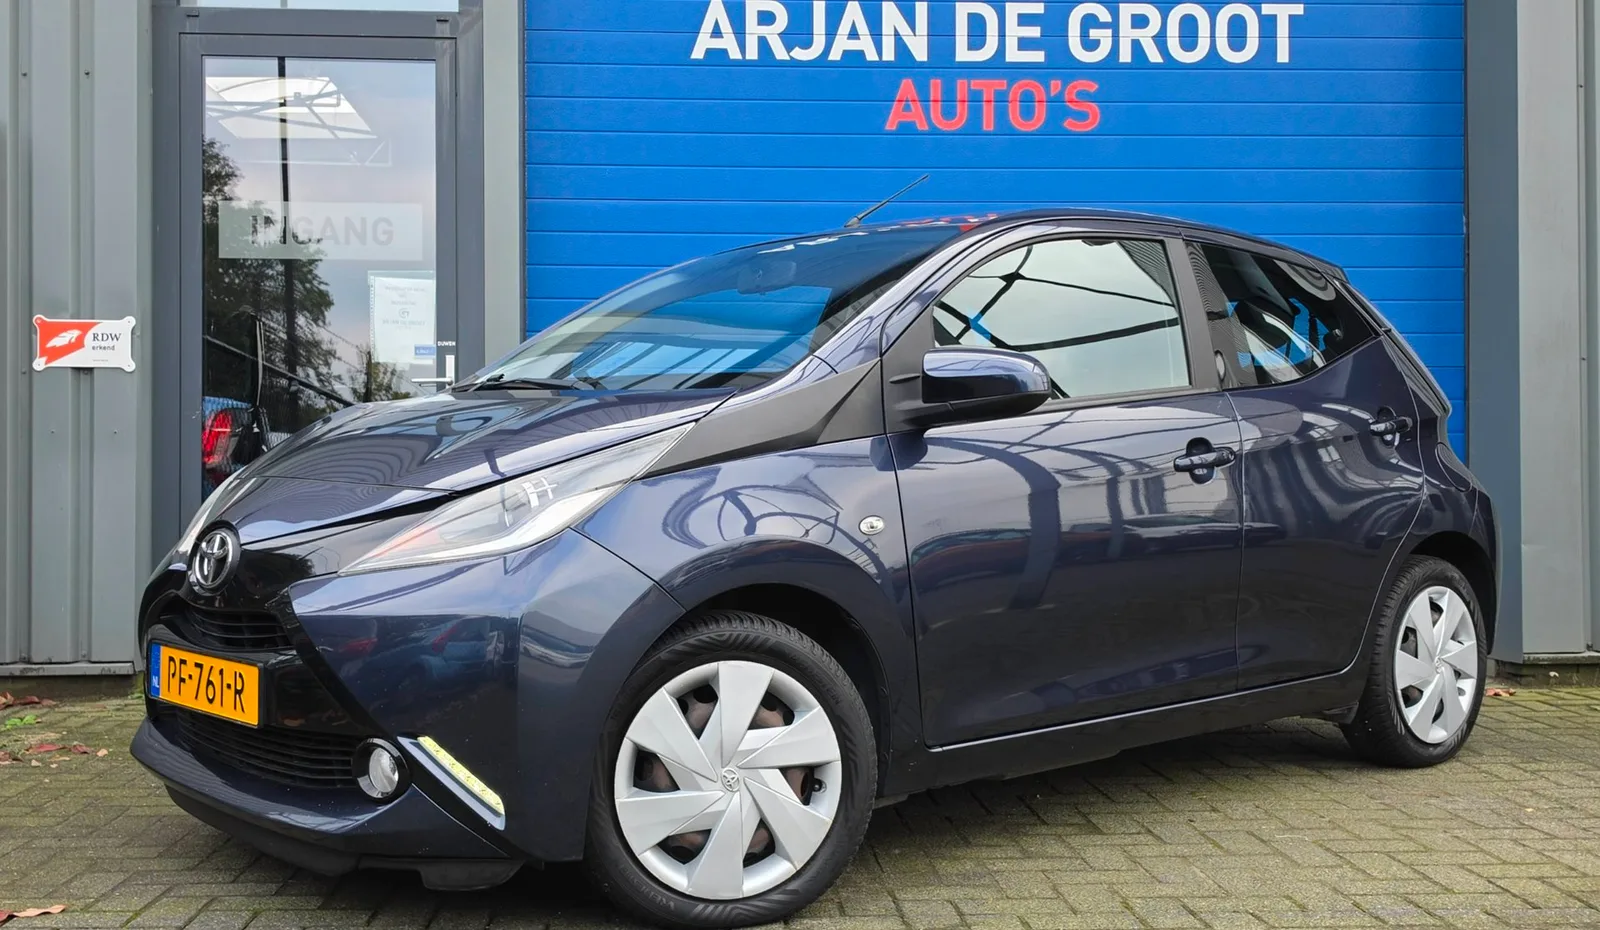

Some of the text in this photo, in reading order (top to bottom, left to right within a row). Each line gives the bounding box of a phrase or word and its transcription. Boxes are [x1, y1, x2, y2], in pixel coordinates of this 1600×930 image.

[691, 0, 1305, 64] ARJAN DE GROOT
[886, 79, 1101, 132] AUTO'S
[92, 332, 122, 342] RDW
[152, 675, 160, 688] NL
[167, 655, 245, 713] PF-761-R
